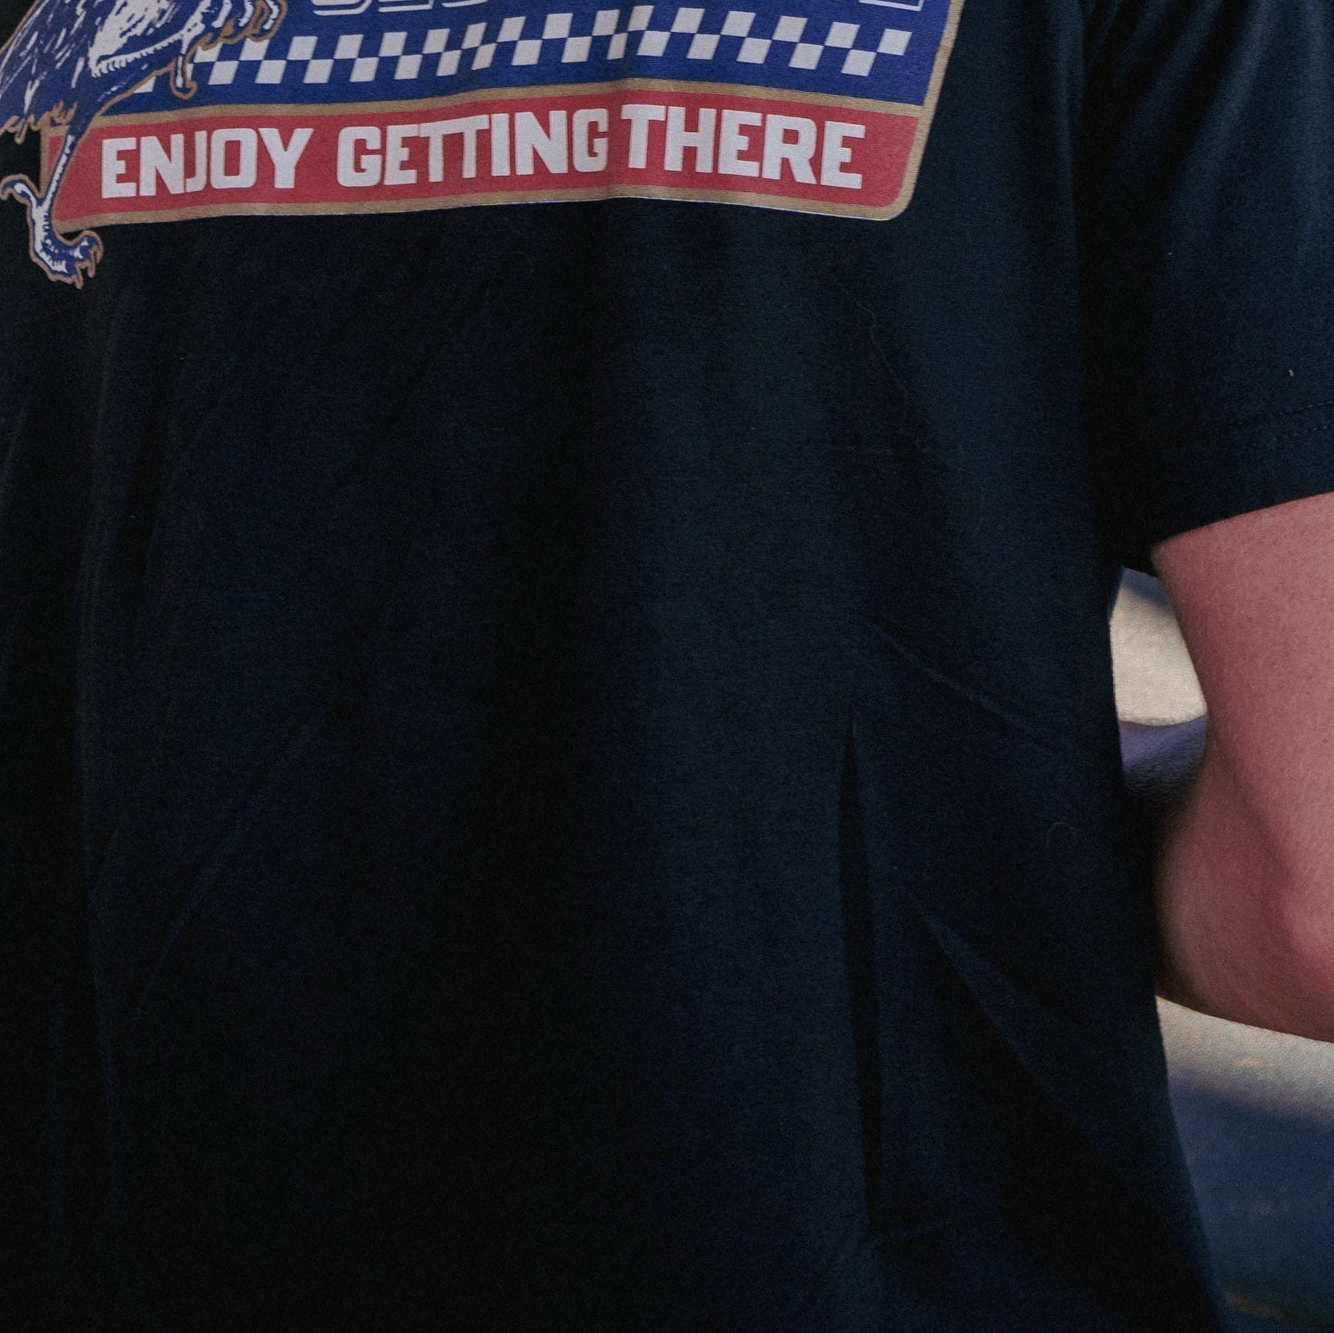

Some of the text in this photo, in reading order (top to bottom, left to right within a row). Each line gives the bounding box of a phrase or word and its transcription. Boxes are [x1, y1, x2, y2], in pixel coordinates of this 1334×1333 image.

[101, 102, 867, 200] ENJOY GETTING THERE
